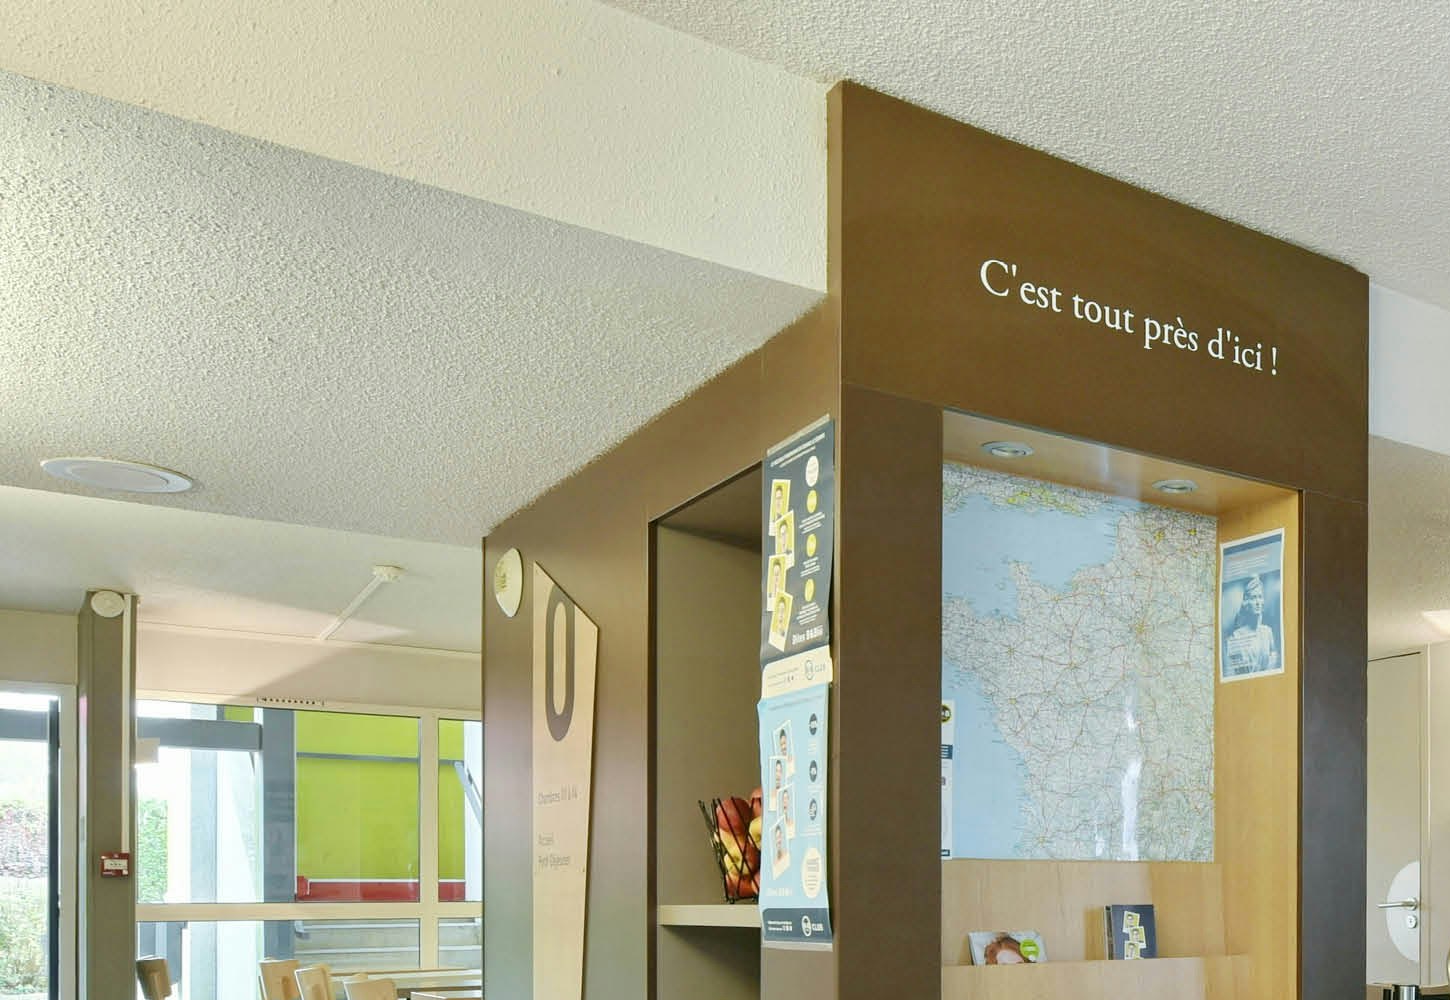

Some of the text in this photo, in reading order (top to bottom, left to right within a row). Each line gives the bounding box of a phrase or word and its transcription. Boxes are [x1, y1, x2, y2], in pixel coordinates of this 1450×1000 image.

[979, 258, 1062, 313] C'est
[1072, 293, 1135, 334] tout
[1143, 316, 1199, 350] près
[1207, 327, 1263, 372] d'ici
